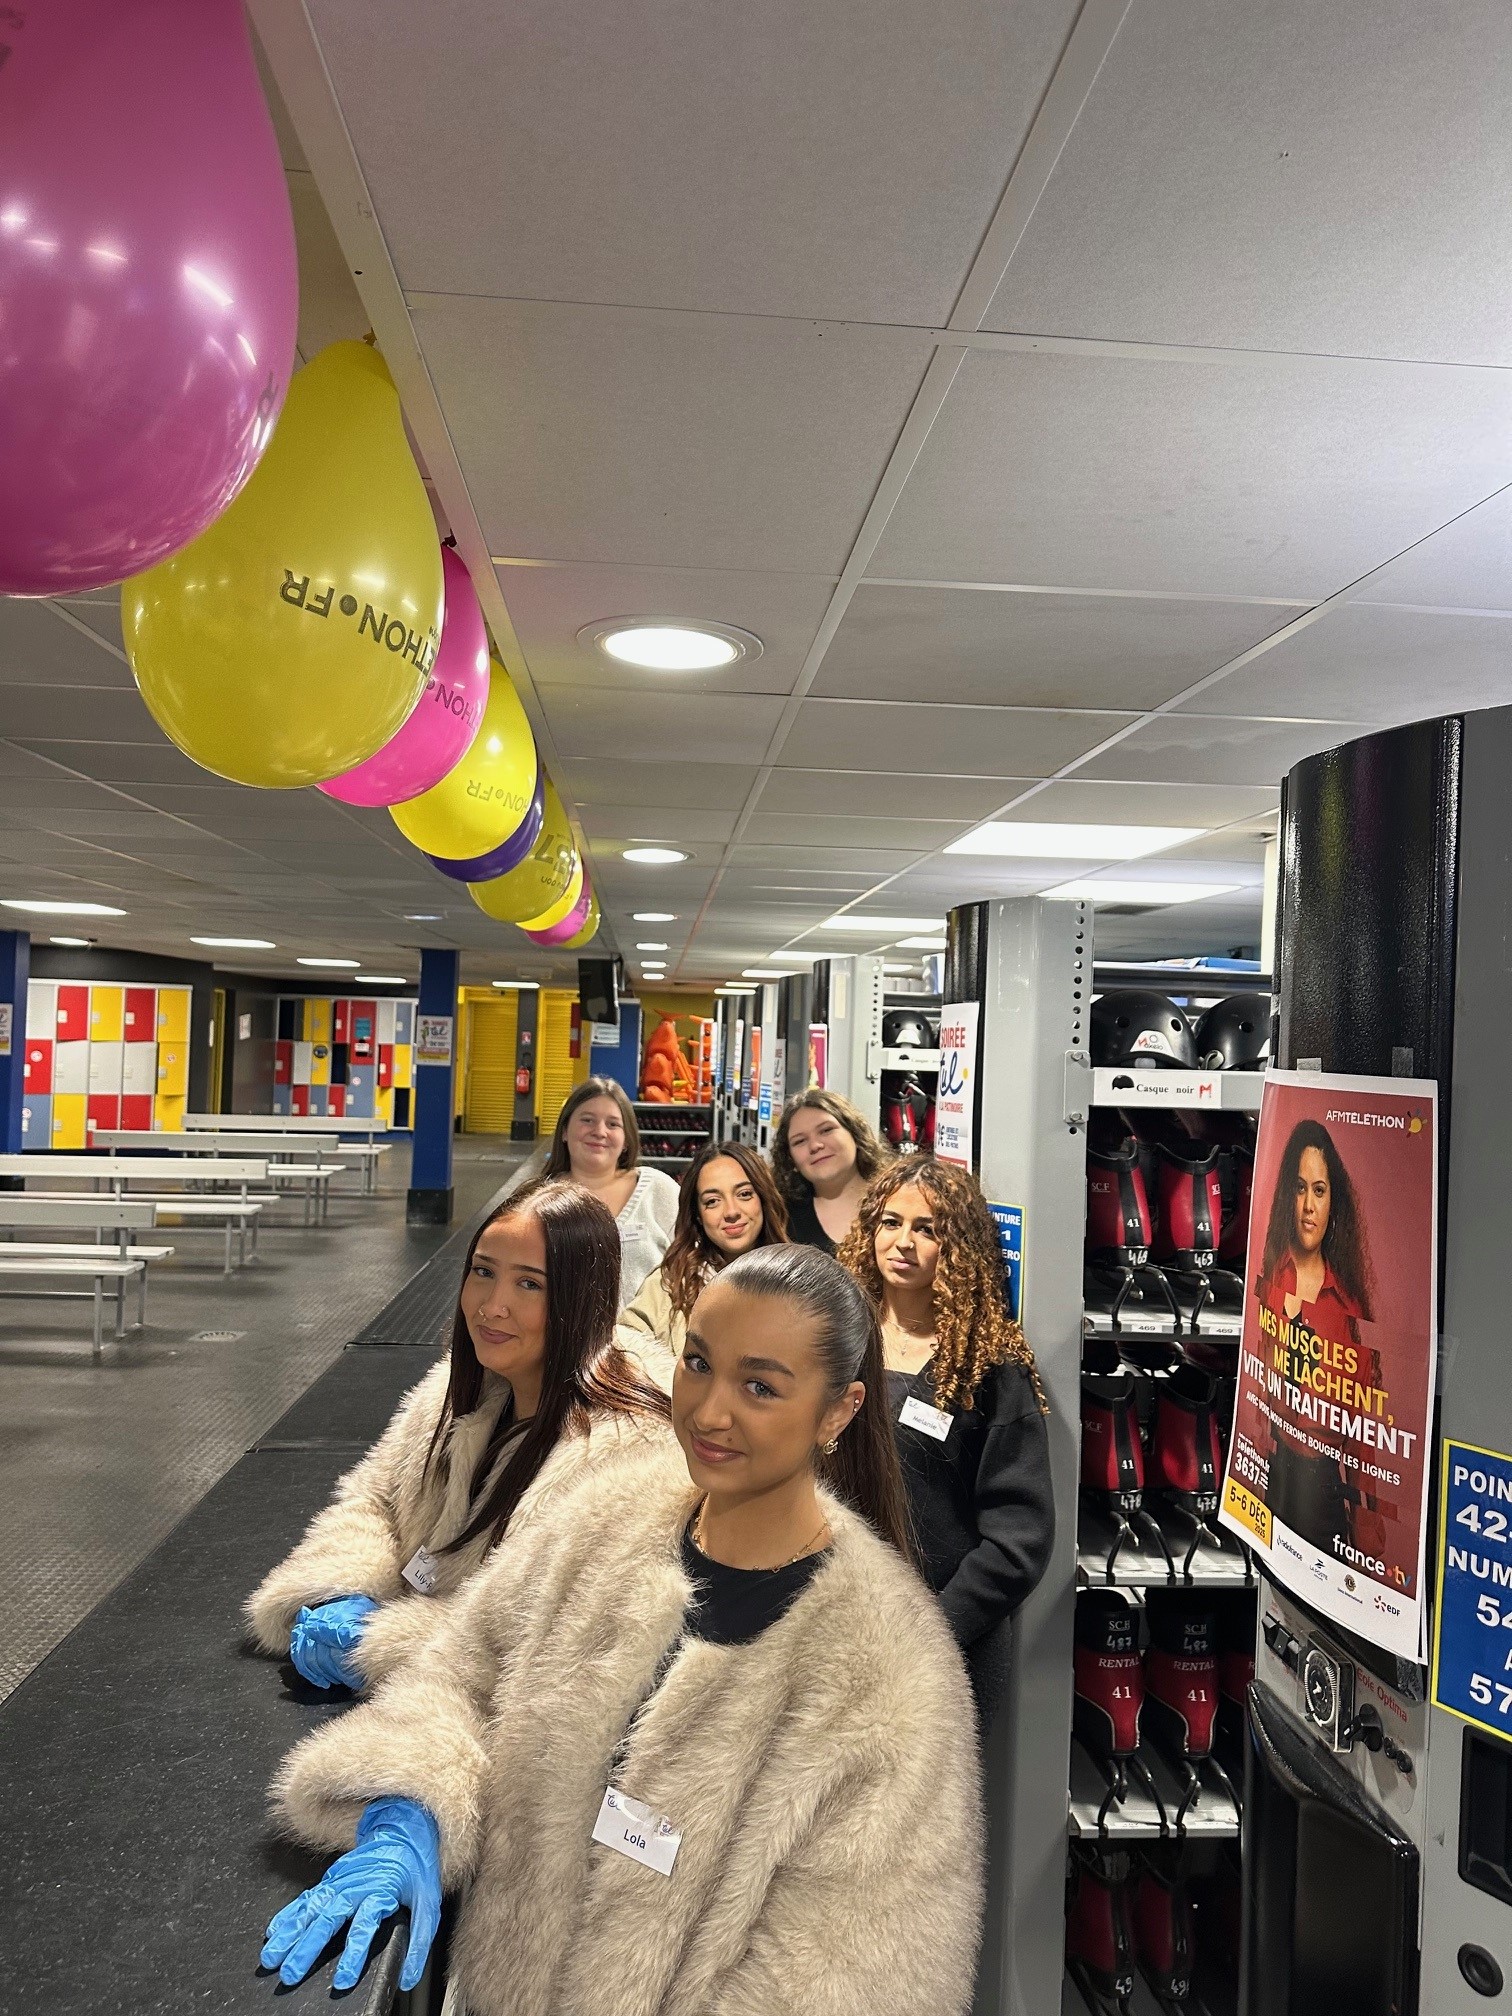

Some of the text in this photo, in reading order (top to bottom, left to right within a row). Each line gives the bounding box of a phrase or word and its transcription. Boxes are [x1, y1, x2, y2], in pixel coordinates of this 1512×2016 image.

[1136, 1083, 1169, 1095] Casque
[1176, 1085, 1195, 1094] noir
[1126, 1218, 1140, 1228] 41
[1197, 1222, 1211, 1232] 41
[1194, 1253, 1214, 1268] 469
[1258, 1304, 1359, 1374] MES MUSCLES
[1273, 1344, 1395, 1426] ME LÂCHENT,
[1243, 1349, 1417, 1460] VITE, UN TRAITEMENT
[1245, 1390, 1259, 1407] AVEC
[1282, 1420, 1308, 1445] FERONS
[1308, 1436, 1342, 1462] BOUGER
[1343, 1452, 1360, 1471] LES
[1361, 1460, 1401, 1486] LIGNES
[1121, 1458, 1135, 1470] 41
[1201, 1463, 1214, 1474] 41
[1235, 1451, 1260, 1486] 3637
[1229, 1485, 1267, 1529] 5-6 DÉC
[1254, 1522, 1266, 1539] 2025
[1106, 1634, 1132, 1651] 487
[1098, 1656, 1140, 1669] RENTAL
[1173, 1660, 1215, 1671] RENTAL
[1112, 1686, 1132, 1699] 41
[1187, 1689, 1207, 1702] 41
[1377, 1689, 1408, 1723] Optima
[623, 1829, 646, 1850] Lola
